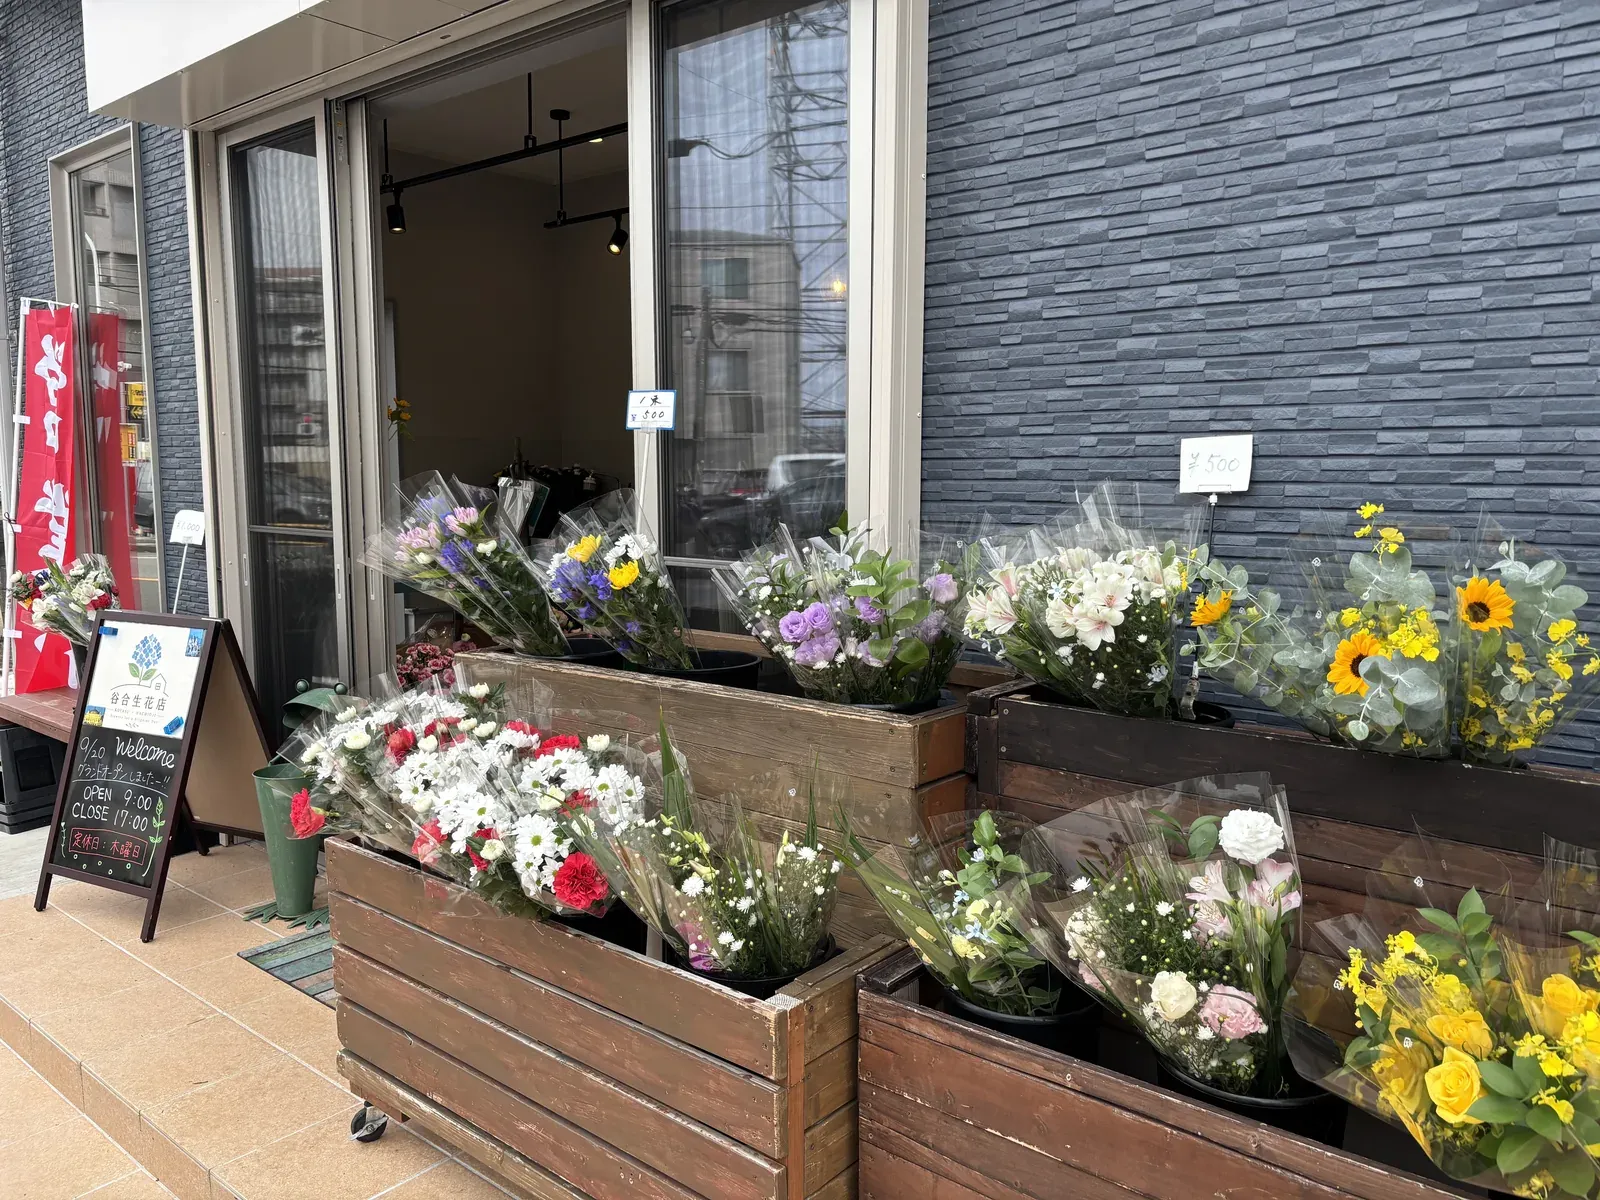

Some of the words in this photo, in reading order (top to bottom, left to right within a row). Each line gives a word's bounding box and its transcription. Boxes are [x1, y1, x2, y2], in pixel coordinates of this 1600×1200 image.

[111, 692, 167, 711] 谷合生花店
[80, 737, 106, 762] 9/20
[115, 736, 175, 769] Welcome
[83, 785, 112, 801] OPEN
[124, 789, 152, 811] 9:00
[72, 802, 109, 821] CLOSE
[113, 809, 148, 831] 17:00
